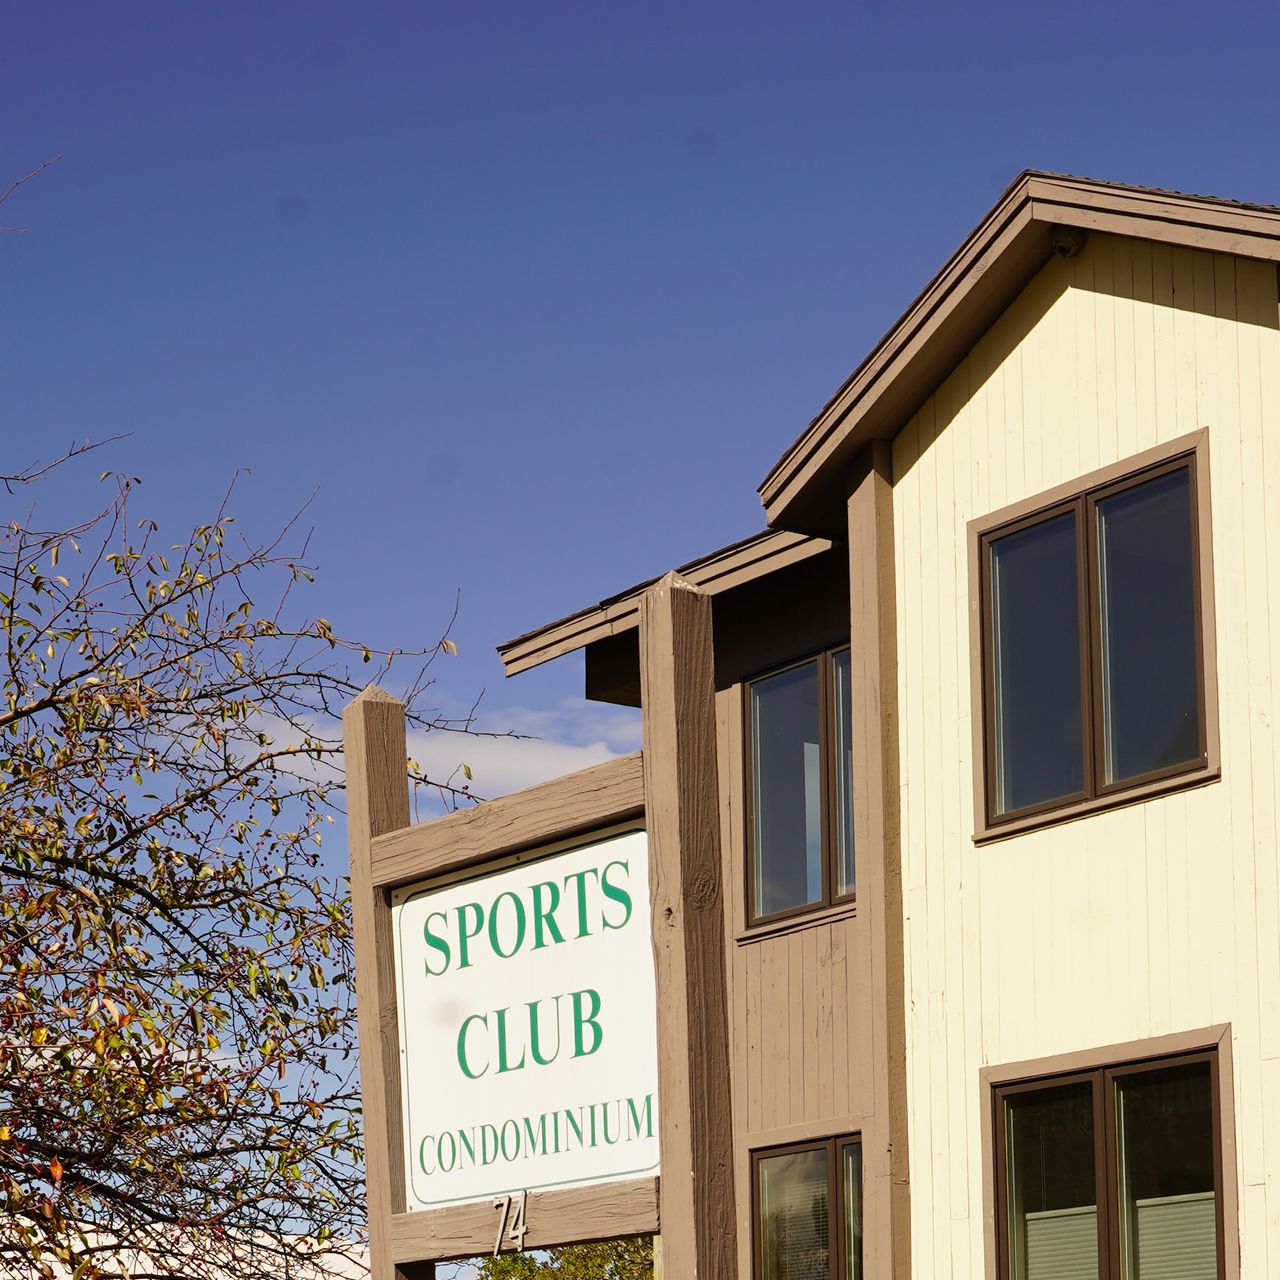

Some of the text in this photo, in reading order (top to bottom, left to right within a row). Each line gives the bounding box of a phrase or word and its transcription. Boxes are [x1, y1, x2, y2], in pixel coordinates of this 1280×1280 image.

[423, 860, 633, 976] SPORTS
[457, 989, 604, 1079] CLUB
[419, 1094, 655, 1175] CONDOMINIUM
[494, 1190, 528, 1256] 74
